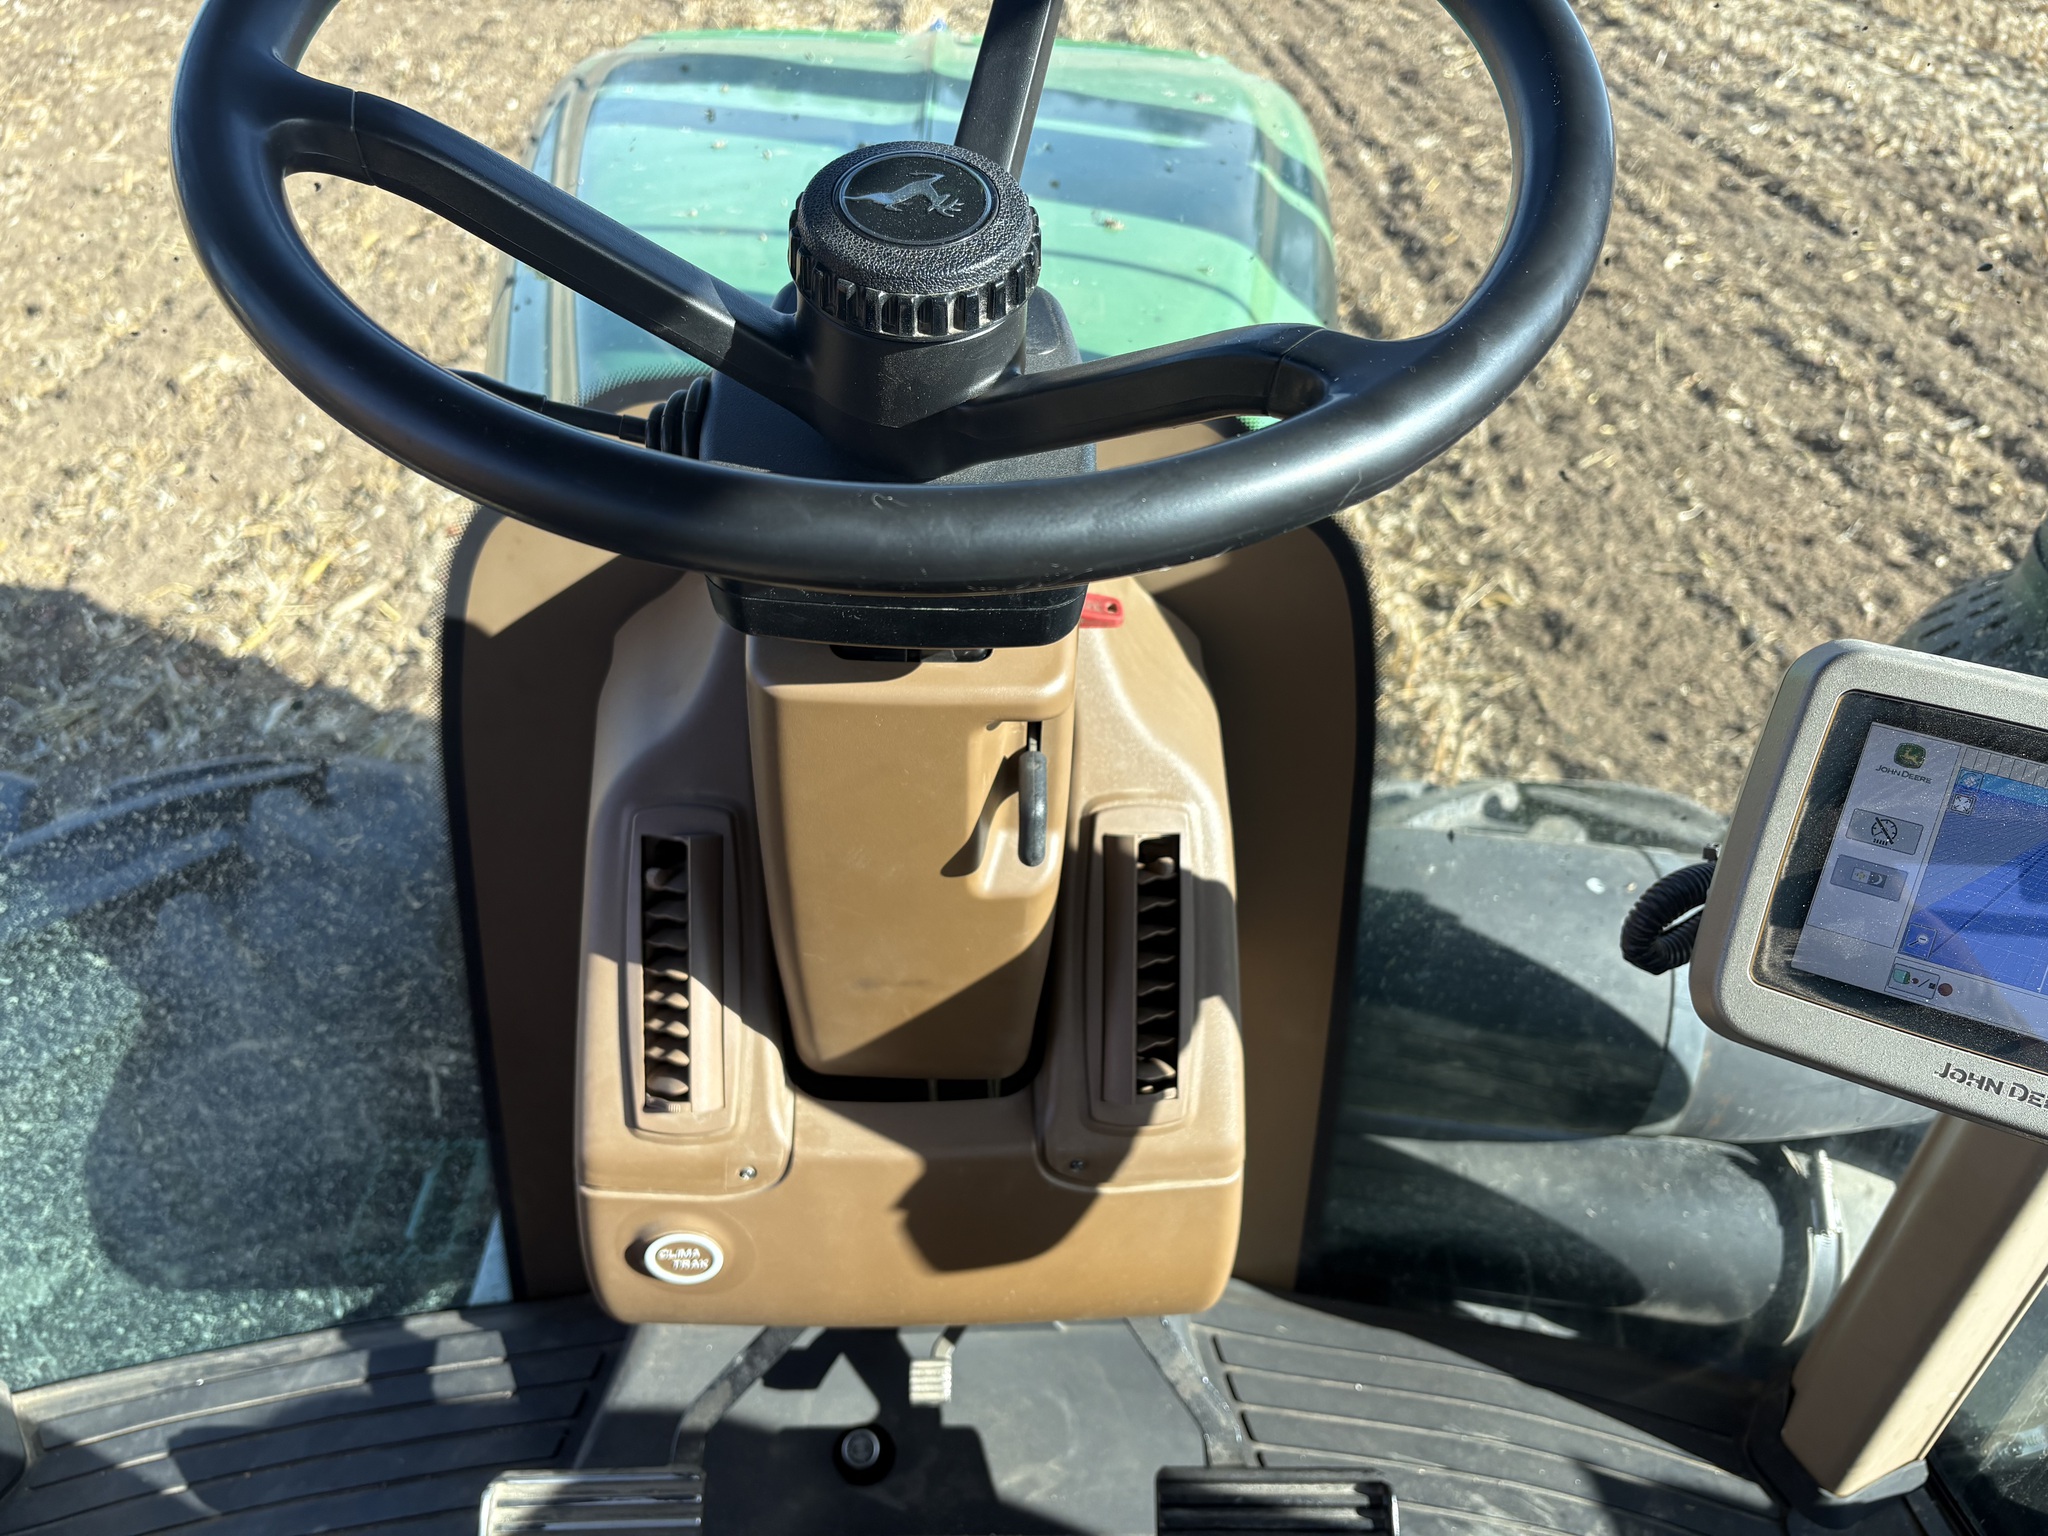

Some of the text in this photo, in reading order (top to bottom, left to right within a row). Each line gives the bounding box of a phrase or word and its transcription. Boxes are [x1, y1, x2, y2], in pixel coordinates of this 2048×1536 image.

[1875, 765, 1933, 785] JOHN DEERE
[1933, 1062, 2048, 1110] JOHN DE
[659, 1248, 701, 1260] CLIMA
[673, 1259, 710, 1270] TRAK
